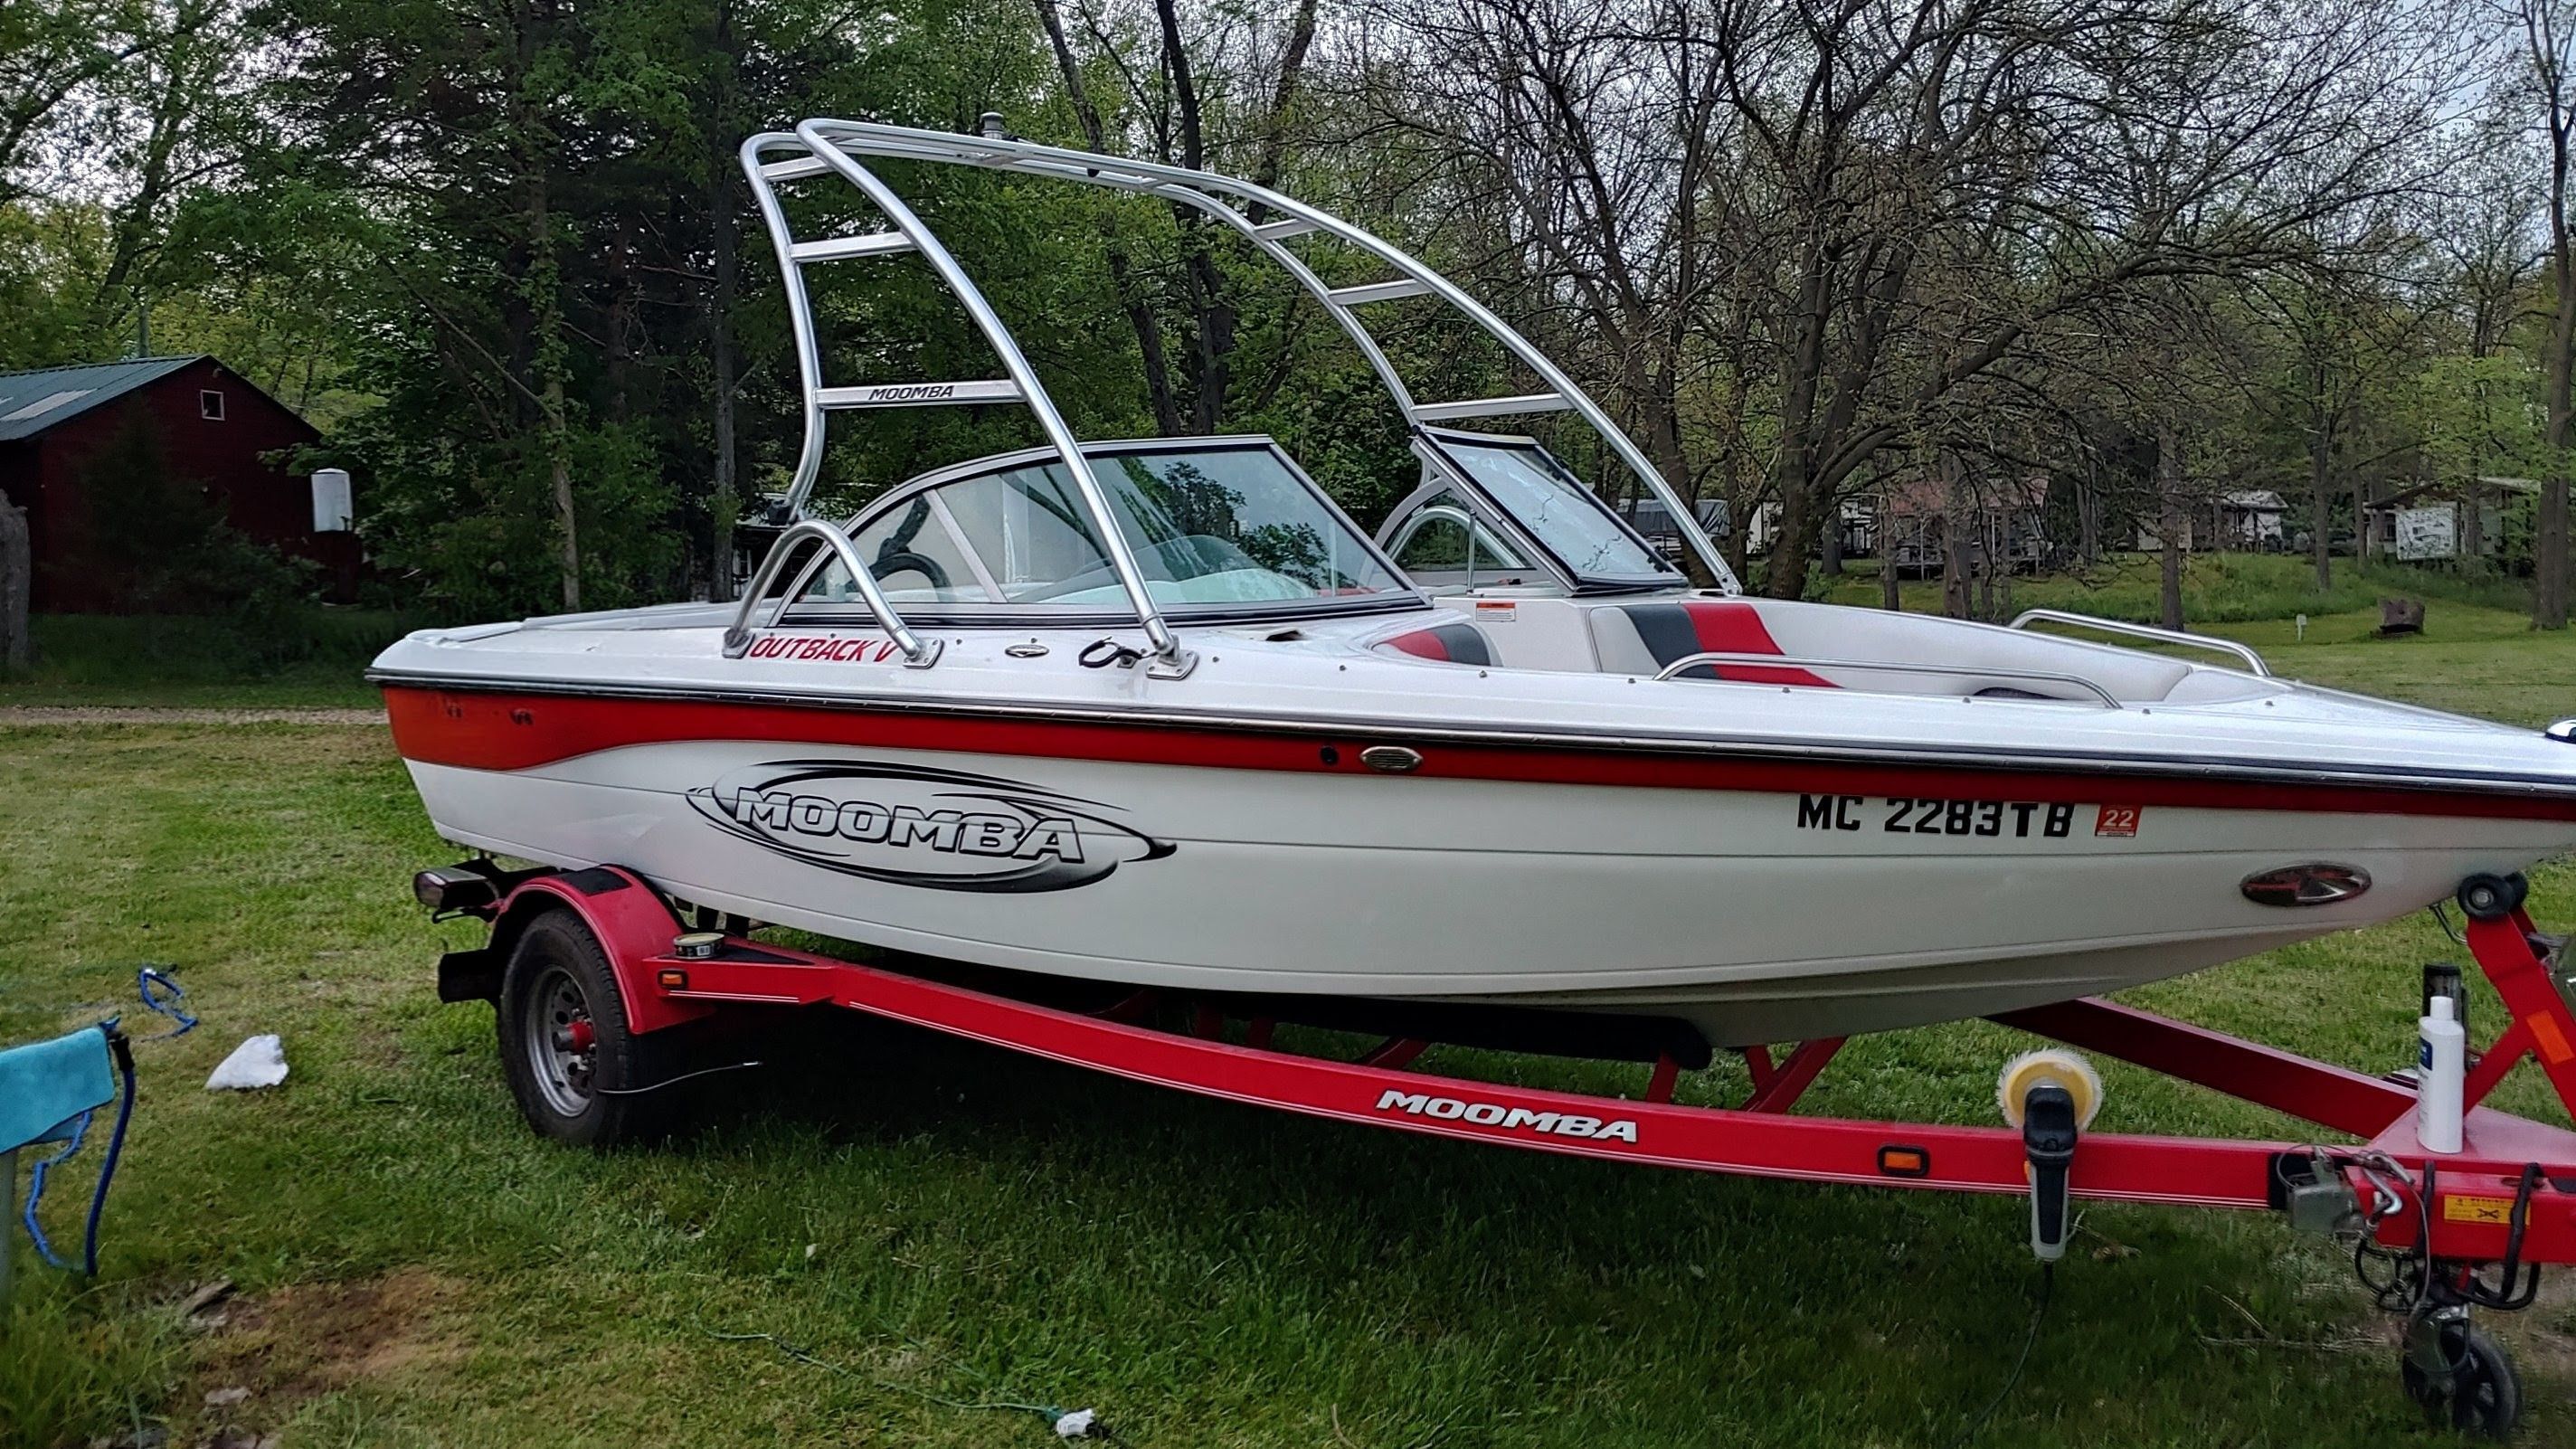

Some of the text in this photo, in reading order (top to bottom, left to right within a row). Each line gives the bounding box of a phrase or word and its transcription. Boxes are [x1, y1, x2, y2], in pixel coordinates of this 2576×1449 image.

[868, 385, 955, 401] MOOMBA
[750, 638, 877, 662] OUTBACK
[735, 787, 1085, 864] MOOMBA
[1797, 793, 1863, 831] MC
[2103, 810, 2135, 827] 22
[1377, 1090, 1637, 1142] MOOMBA
